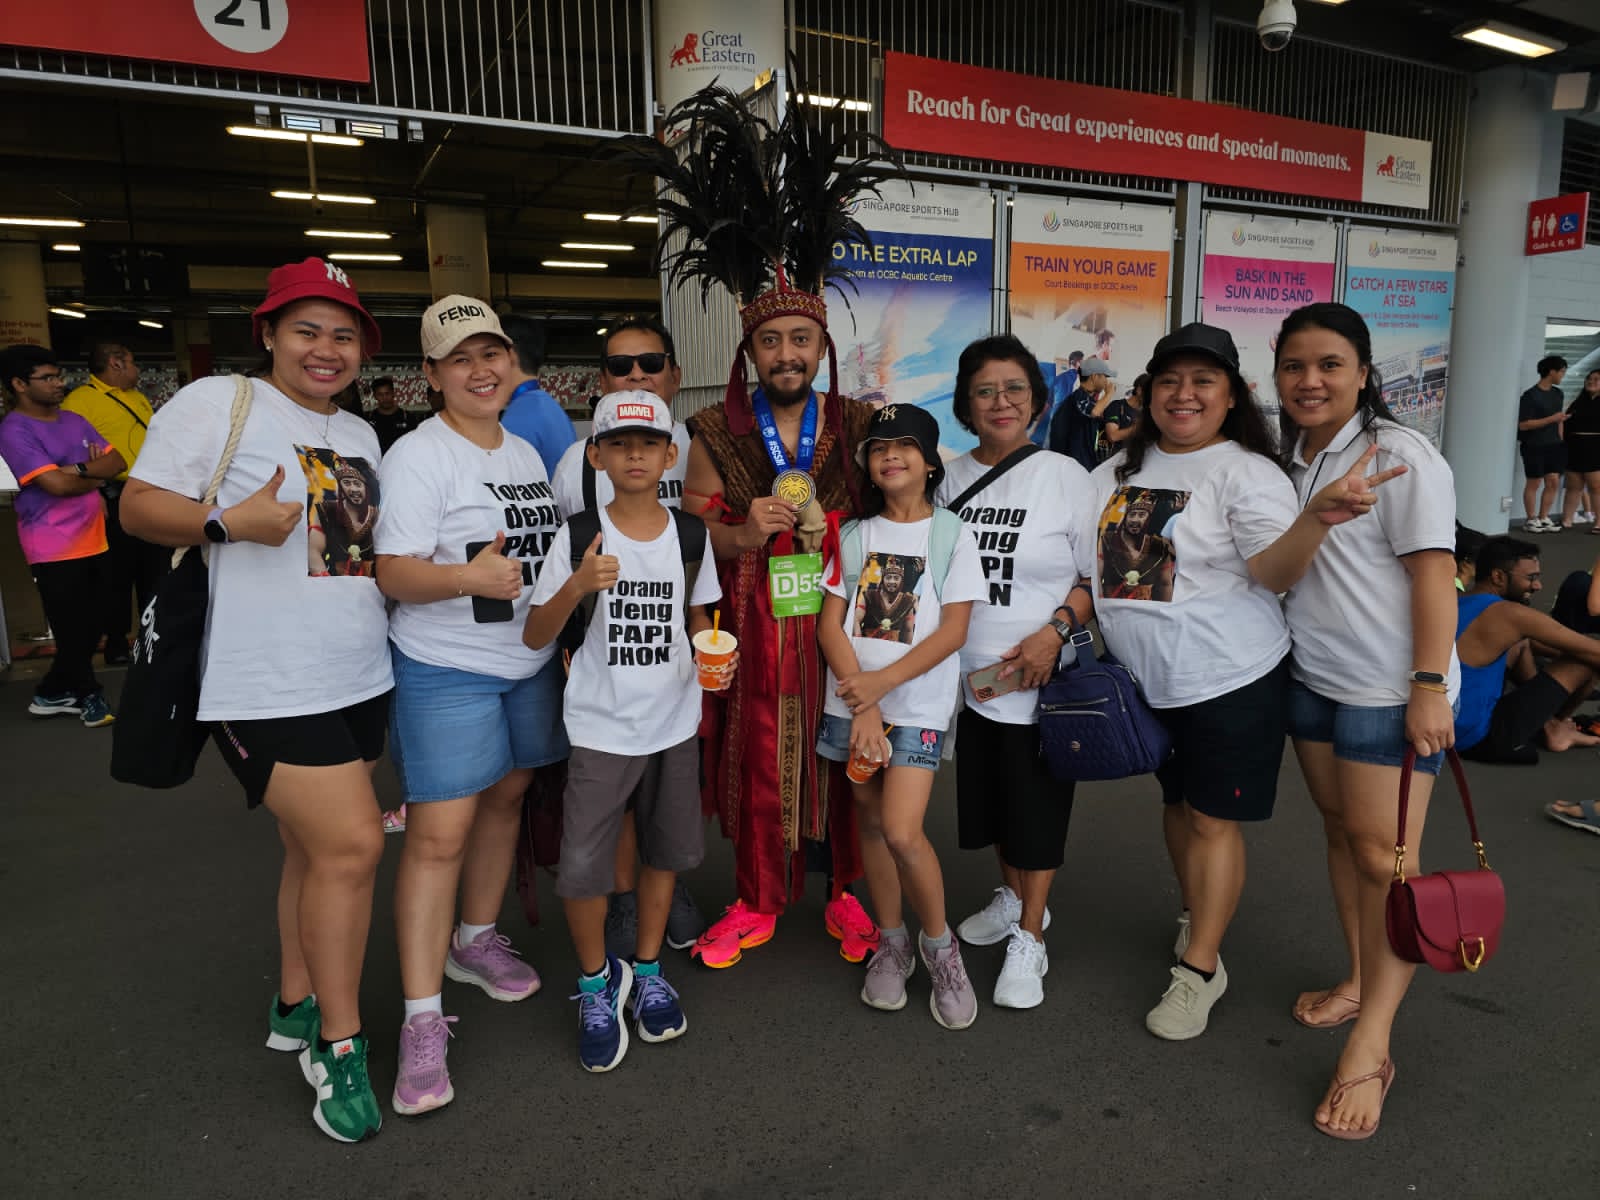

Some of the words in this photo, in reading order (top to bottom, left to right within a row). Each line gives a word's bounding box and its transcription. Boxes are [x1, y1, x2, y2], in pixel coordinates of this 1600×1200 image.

[702, 31, 742, 47] Great
[702, 47, 755, 64] Eastern
[907, 88, 975, 121] Reach
[980, 98, 1011, 125] for
[1015, 104, 1071, 133] Great
[1075, 117, 1184, 149] experiences
[1186, 132, 1219, 154] and
[1222, 138, 1278, 162] special
[1280, 148, 1351, 172] moments.
[862, 201, 910, 213] SINGAPORE
[911, 205, 942, 215] SPORTS
[943, 207, 959, 217] HUB
[1062, 218, 1102, 230] SINGAPORE
[1103, 222, 1128, 231] SPORTS
[1129, 223, 1144, 232] HUB
[849, 243, 885, 262] THE
[889, 245, 943, 265] EXTRA
[947, 250, 978, 268] LAP
[324, 262, 351, 289] NY
[1024, 255, 1069, 273] TRAIN
[1073, 259, 1113, 275] YOUR
[1117, 261, 1158, 277] GAME
[876, 270, 900, 280] OCBC
[901, 271, 928, 282] Aquatic
[929, 272, 953, 283] Centre
[1235, 268, 1266, 283] BASK
[1268, 270, 1281, 284] IN
[1284, 271, 1307, 286] THE
[1350, 277, 1384, 291] CATCH
[1386, 279, 1394, 291] A
[1396, 279, 1417, 293] FEW
[1418, 280, 1448, 294] STARS
[1225, 284, 1251, 299] SUN
[1253, 286, 1279, 301] AND
[1281, 288, 1314, 303] SAND
[1383, 294, 1396, 307] AT
[1398, 294, 1416, 308] SEA
[438, 305, 486, 326] FENDI
[619, 405, 652, 418] MARVEL
[959, 506, 1027, 527] orang
[778, 575, 794, 595] D
[609, 598, 673, 622] deng
[608, 623, 672, 644] PAPI
[608, 646, 670, 666] JHON
